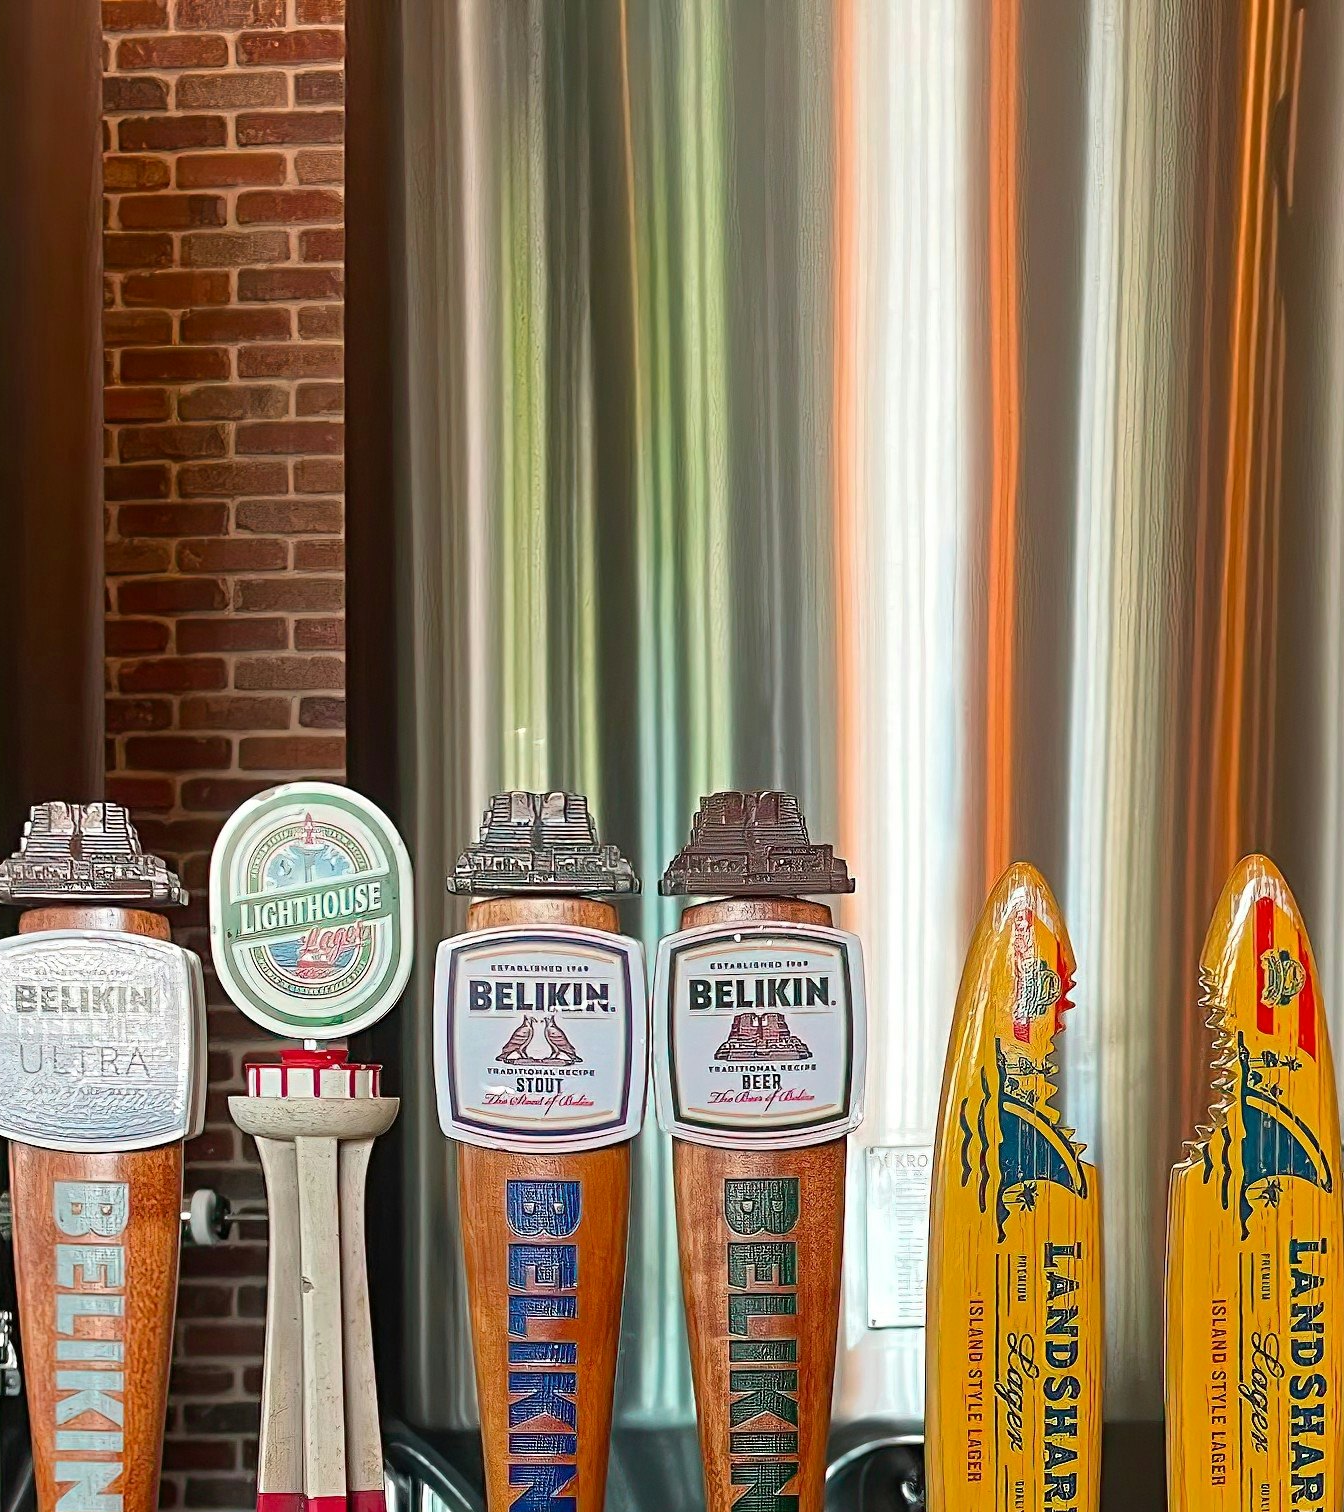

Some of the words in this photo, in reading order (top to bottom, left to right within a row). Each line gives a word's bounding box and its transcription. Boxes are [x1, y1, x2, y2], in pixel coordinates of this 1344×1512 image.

[239, 881, 383, 936] LIGHTHOUSE
[301, 920, 368, 964] Lager
[15, 984, 153, 1014] BELIKIN
[20, 1044, 152, 1079] ULTRA
[515, 1077, 564, 1093] STOUT
[742, 1073, 782, 1090] BEER
[1017, 1253, 1028, 1303] PREMIUM
[1260, 1253, 1272, 1300] PREMIUM
[967, 1299, 984, 1362] ISLAND
[1211, 1299, 1227, 1362] ISLAND
[967, 1368, 984, 1423] STYLE
[994, 1332, 1040, 1453] Lager
[1210, 1368, 1227, 1425] STYLE
[1237, 1331, 1286, 1454] Lager
[966, 1428, 984, 1483] LAGER
[1210, 1429, 1226, 1487] LAGER
